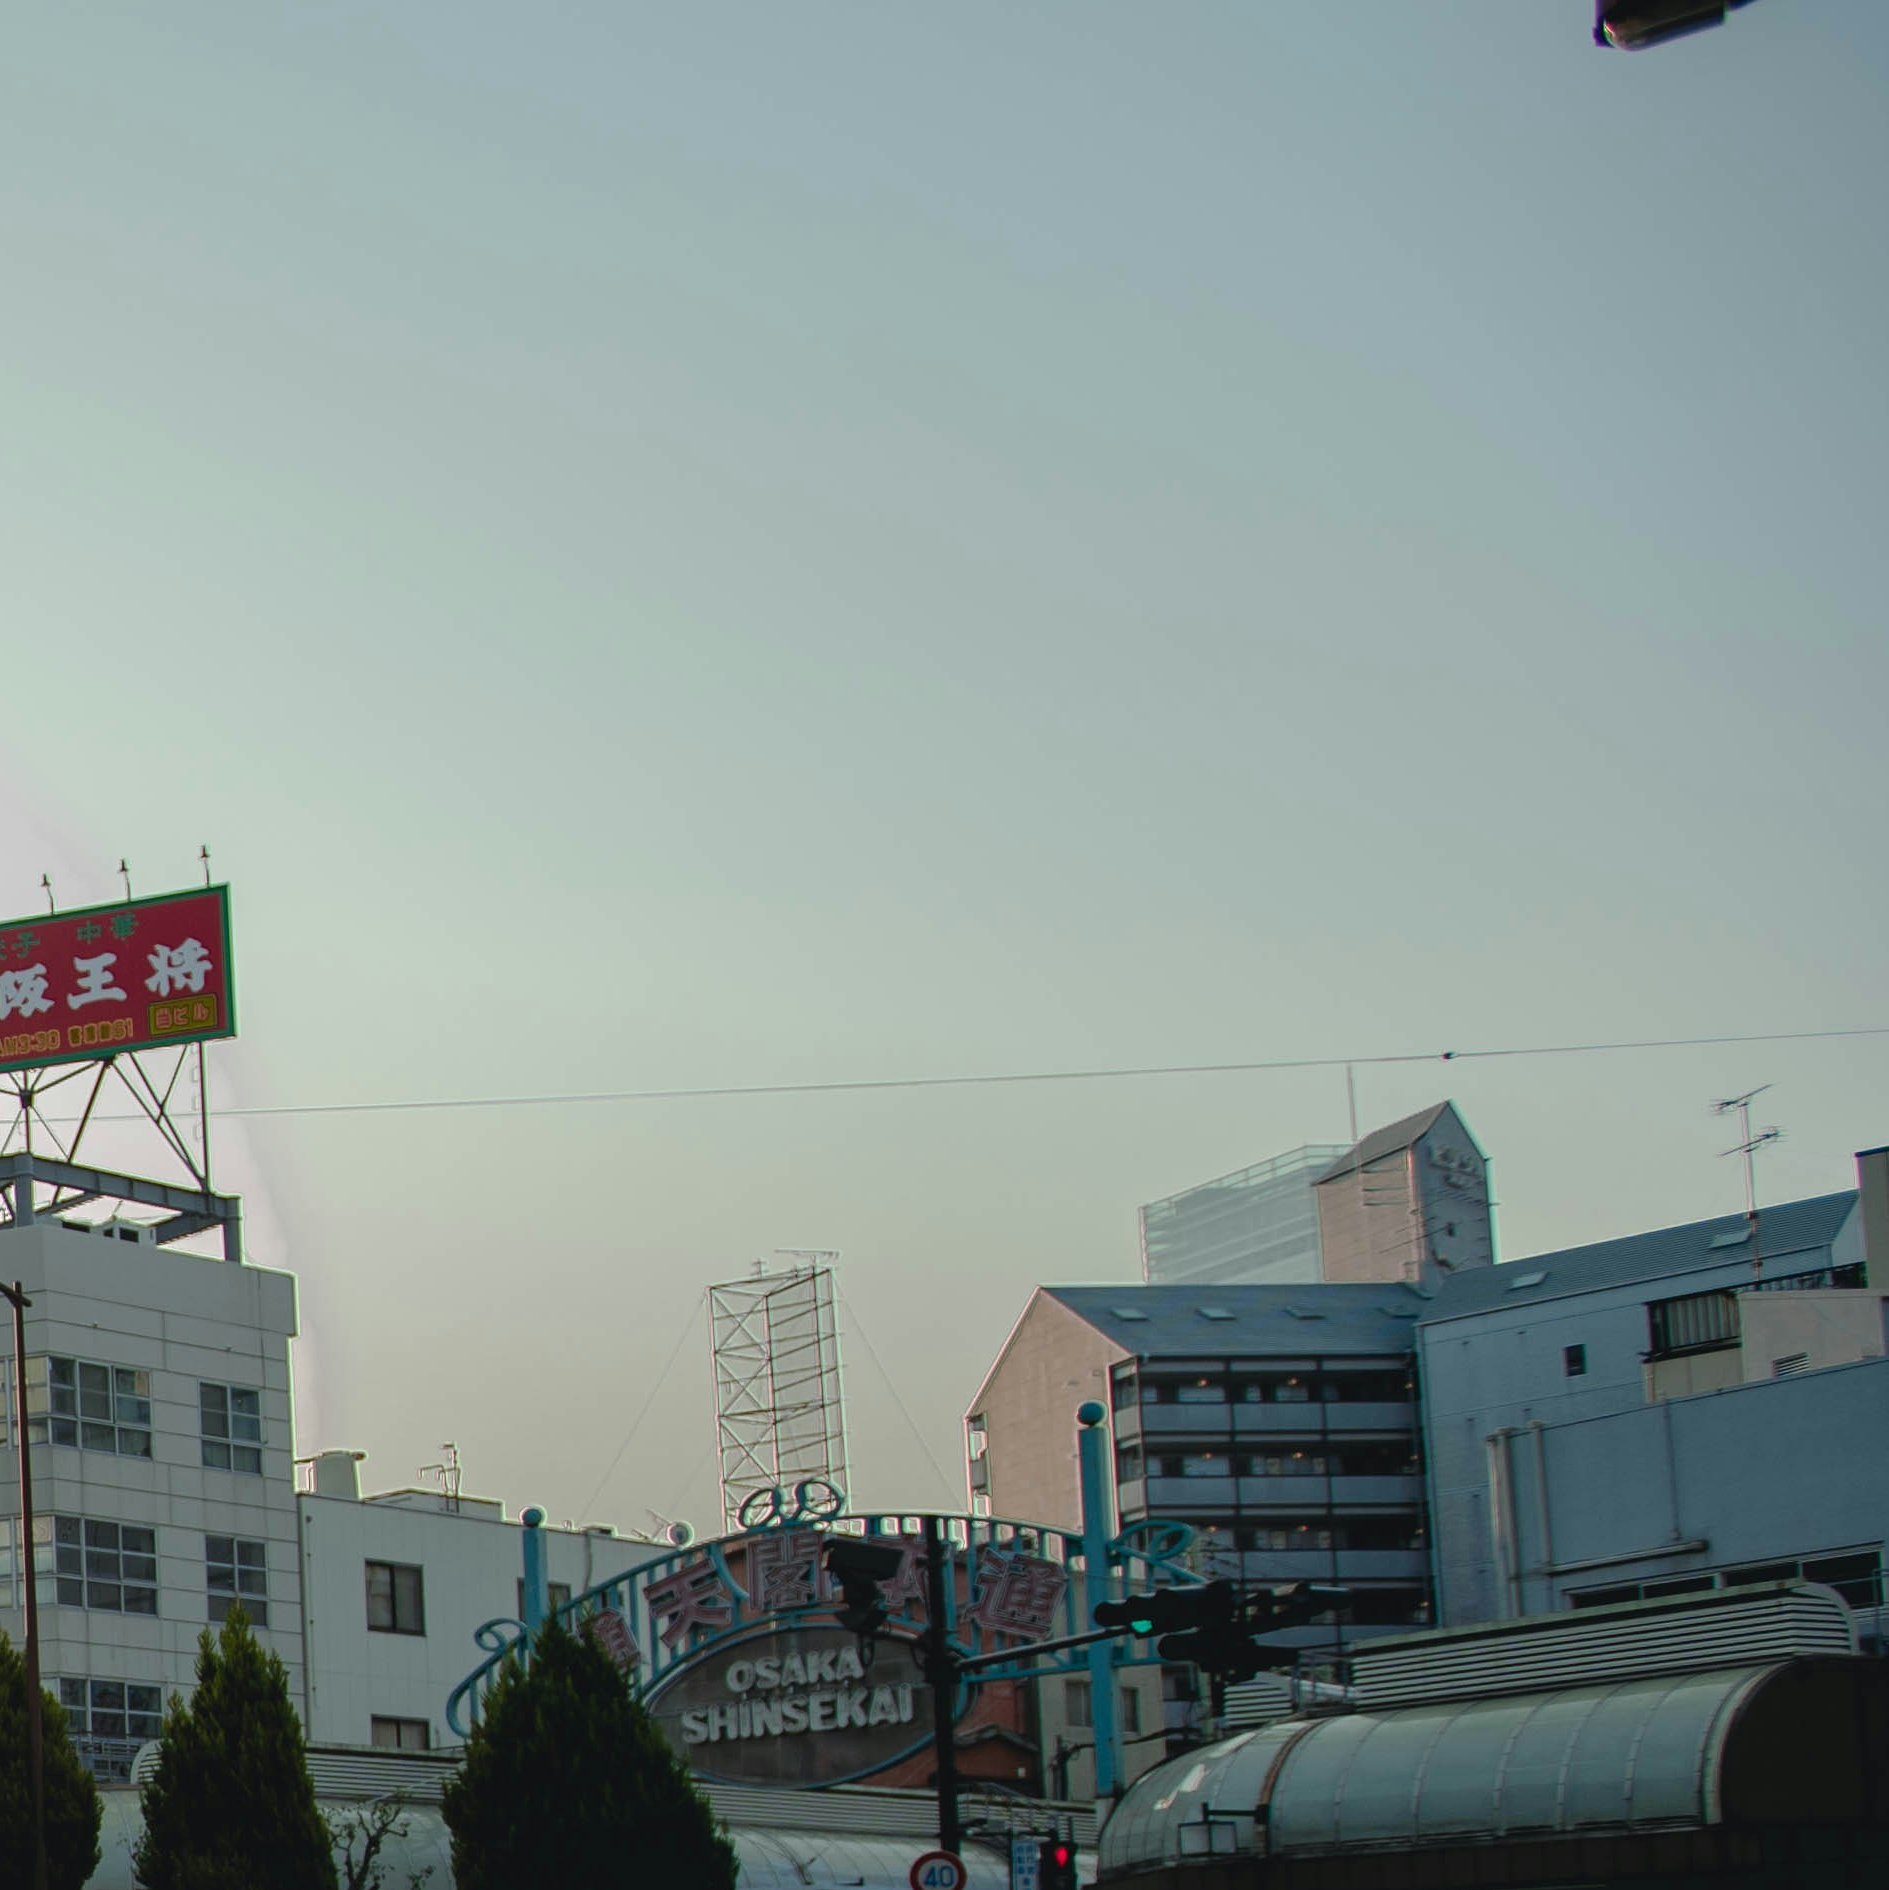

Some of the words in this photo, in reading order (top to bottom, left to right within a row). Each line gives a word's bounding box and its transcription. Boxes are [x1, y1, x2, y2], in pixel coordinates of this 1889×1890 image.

[725, 1646, 866, 1694] OSAKA
[681, 1681, 914, 1746] SHINSEKAI
[924, 1865, 955, 1888] 40
